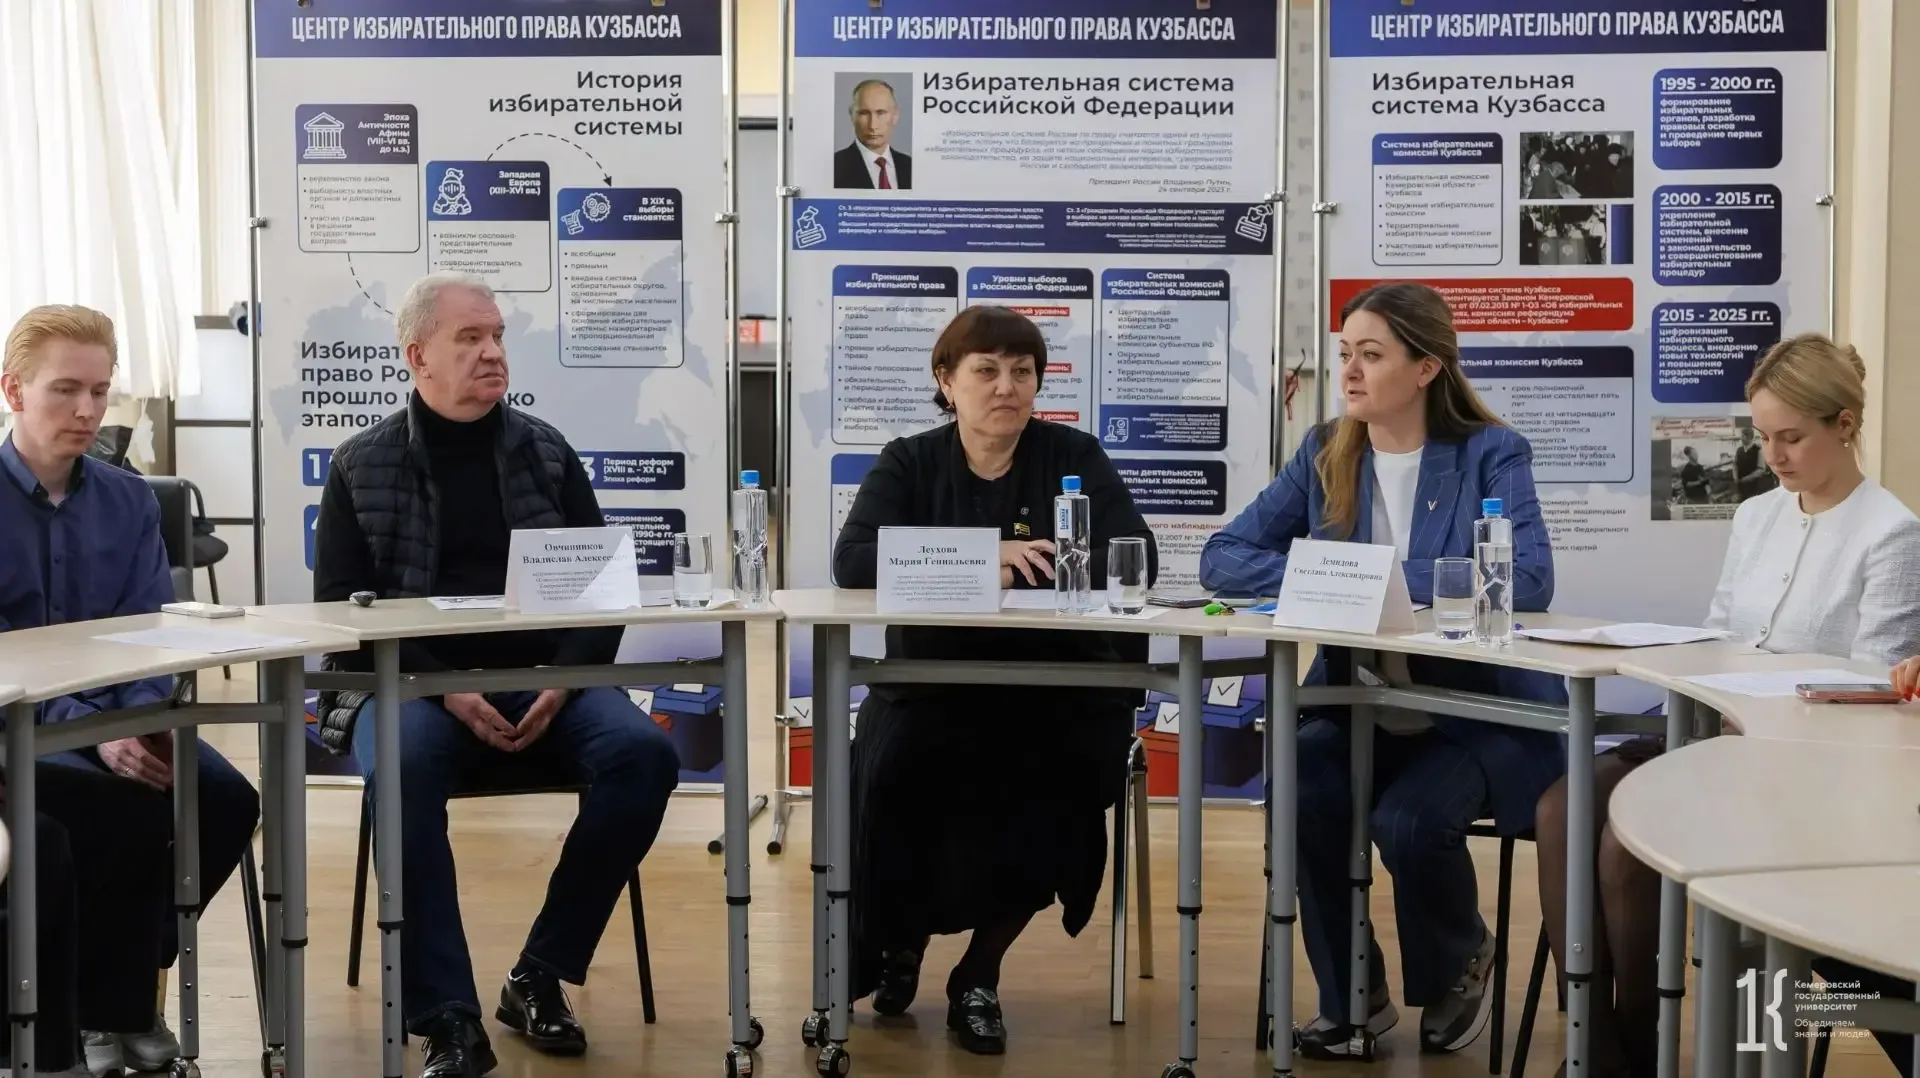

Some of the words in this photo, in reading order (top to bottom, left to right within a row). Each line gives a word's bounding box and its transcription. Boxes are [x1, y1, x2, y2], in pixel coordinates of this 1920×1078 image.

[292, 17, 349, 41] ЦЕНТР
[354, 15, 517, 40] ИЗБИРАТЕЛЬНОГО
[521, 15, 580, 39] ПРАВА
[586, 14, 682, 38] КУЗБАССА
[833, 16, 892, 41] ЦЕНТР
[897, 16, 1065, 41] ИЗБИРАТЕЛЬНОГО
[1070, 16, 1131, 41] ПРАВА
[1136, 16, 1235, 41] КУЗБАССА
[1371, 15, 1434, 41] ЦЕНТР
[1437, 11, 1610, 38] ИЗБИРАТЕЛЬНОГО
[1615, 11, 1679, 36] ПРАВА
[1683, 10, 1784, 35] КУЗБАССА
[577, 71, 682, 92] История
[923, 72, 1120, 94] Избирательная
[1128, 77, 1234, 92] система
[1372, 72, 1574, 93] Избирательная
[1660, 77, 1696, 90] 1995
[1710, 76, 1752, 90] 2000
[1756, 79, 1776, 88] гг.
[489, 93, 682, 114] избирательной
[924, 96, 1075, 116] Российской
[1084, 96, 1234, 118] Федерации
[1372, 97, 1478, 114] система
[1487, 95, 1606, 118] Кузбасса
[1660, 106, 1732, 114] избирательных
[574, 119, 682, 136] системы
[378, 130, 410, 138] Афины
[1422, 140, 1494, 150] избирательных
[1660, 140, 1700, 148] выборов
[1393, 148, 1438, 156] комиссий
[1441, 149, 1482, 158] Кузбасса
[1660, 192, 1700, 205] 2000
[1716, 192, 1750, 204] 2015
[1756, 194, 1774, 204] гг.
[639, 206, 674, 214] выборы
[1660, 220, 1731, 228] избирательной
[1668, 252, 1762, 260] совершенствование
[1660, 260, 1732, 268] избирательных
[872, 273, 919, 282] Принципы
[1660, 270, 1706, 278] процедур
[992, 275, 1026, 283] Уровни
[1028, 276, 1067, 284] выборов
[846, 281, 917, 289] избирательного
[980, 282, 1034, 291] Российской
[1035, 284, 1088, 292] Федерации
[1167, 288, 1220, 296] Федерации
[1524, 286, 1560, 294] Кузбасса
[1539, 294, 1594, 302] Кемеровской
[1660, 309, 1694, 322] 2015
[1709, 308, 1747, 321] 2025
[1752, 311, 1770, 320] гг.
[1660, 328, 1728, 336] цифровизация
[1690, 352, 1744, 360] технологий
[1542, 358, 1583, 367] Кузбасса
[302, 367, 372, 385] право
[1660, 376, 1700, 384] выборов
[302, 391, 398, 408] прошло
[302, 413, 383, 427] этапов
[639, 459, 674, 467] реформ
[522, 556, 572, 564] Владислав
[889, 558, 922, 566] Мария
